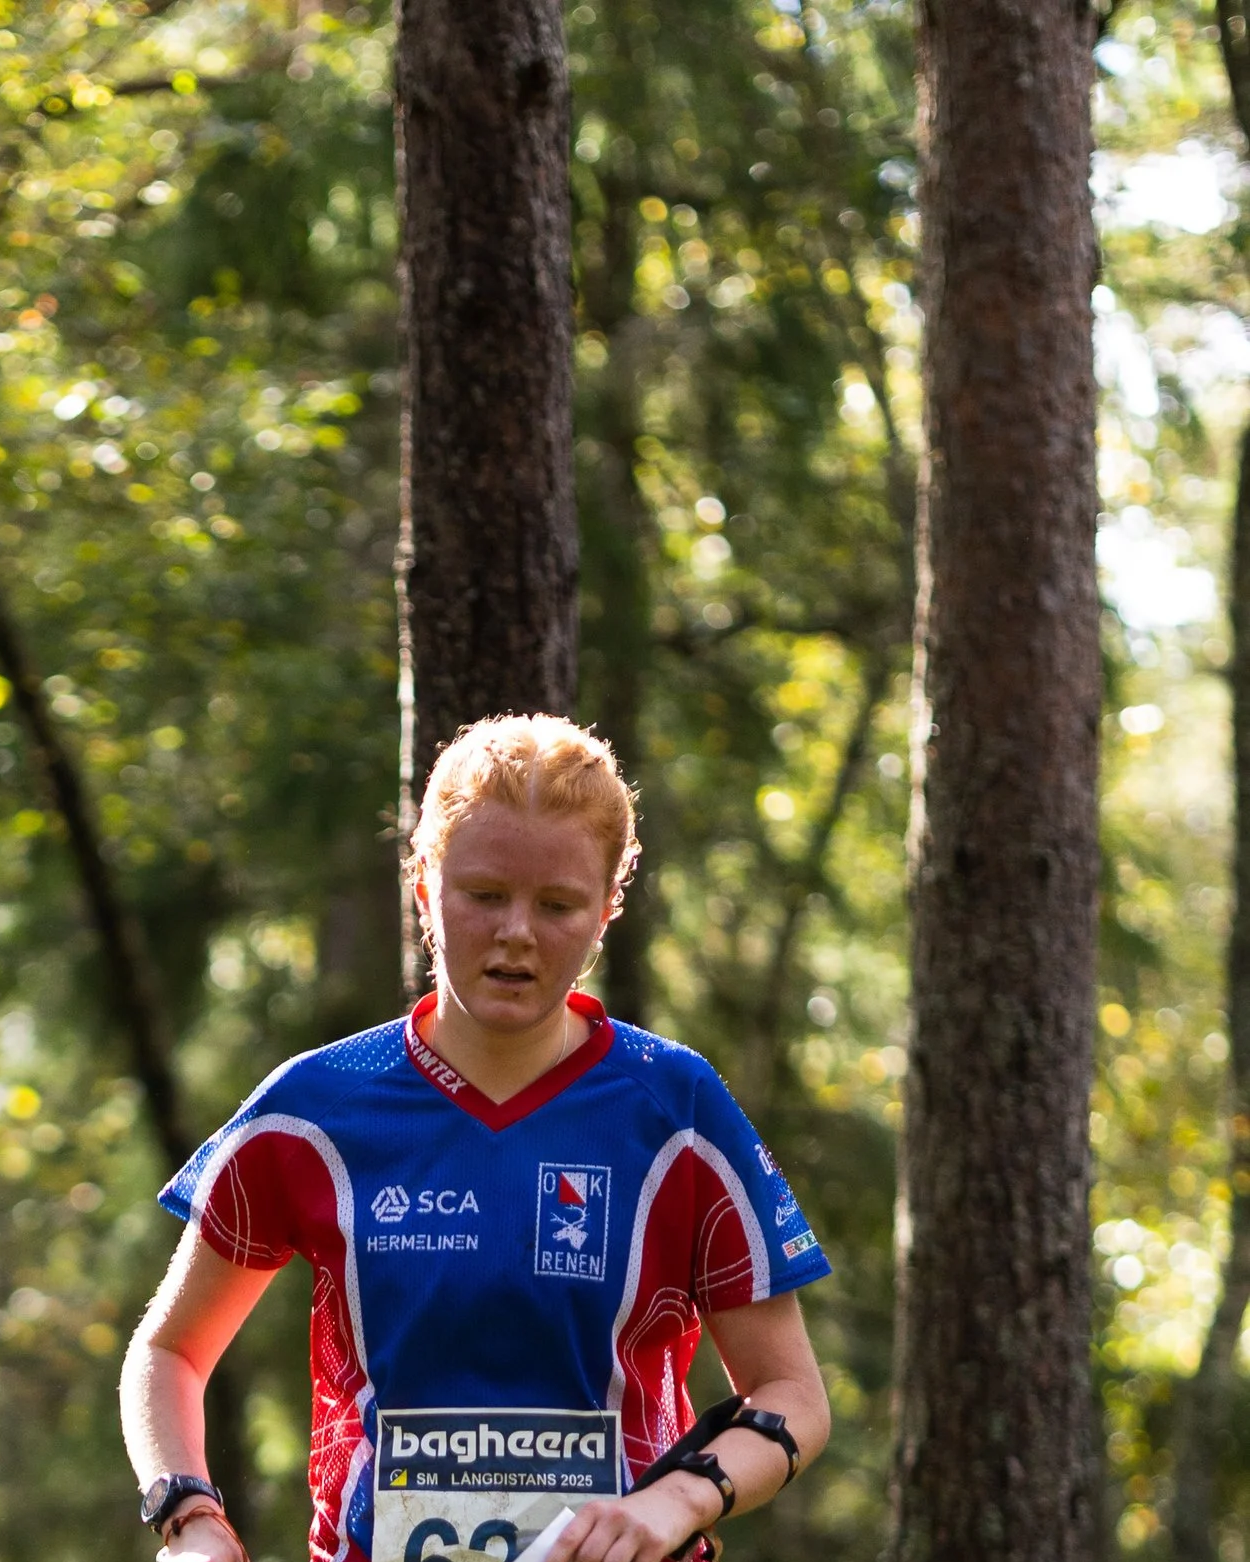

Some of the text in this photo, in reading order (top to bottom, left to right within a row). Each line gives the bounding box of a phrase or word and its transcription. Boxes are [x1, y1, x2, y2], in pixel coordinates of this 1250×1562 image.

[543, 1172, 604, 1198] O K
[417, 1190, 480, 1214] SCA
[367, 1234, 479, 1252] HERMELINEN
[541, 1251, 601, 1275] RENEN
[391, 1423, 606, 1464] bagheera
[416, 1470, 594, 1487] SM LÅNGDISTANS 2025
